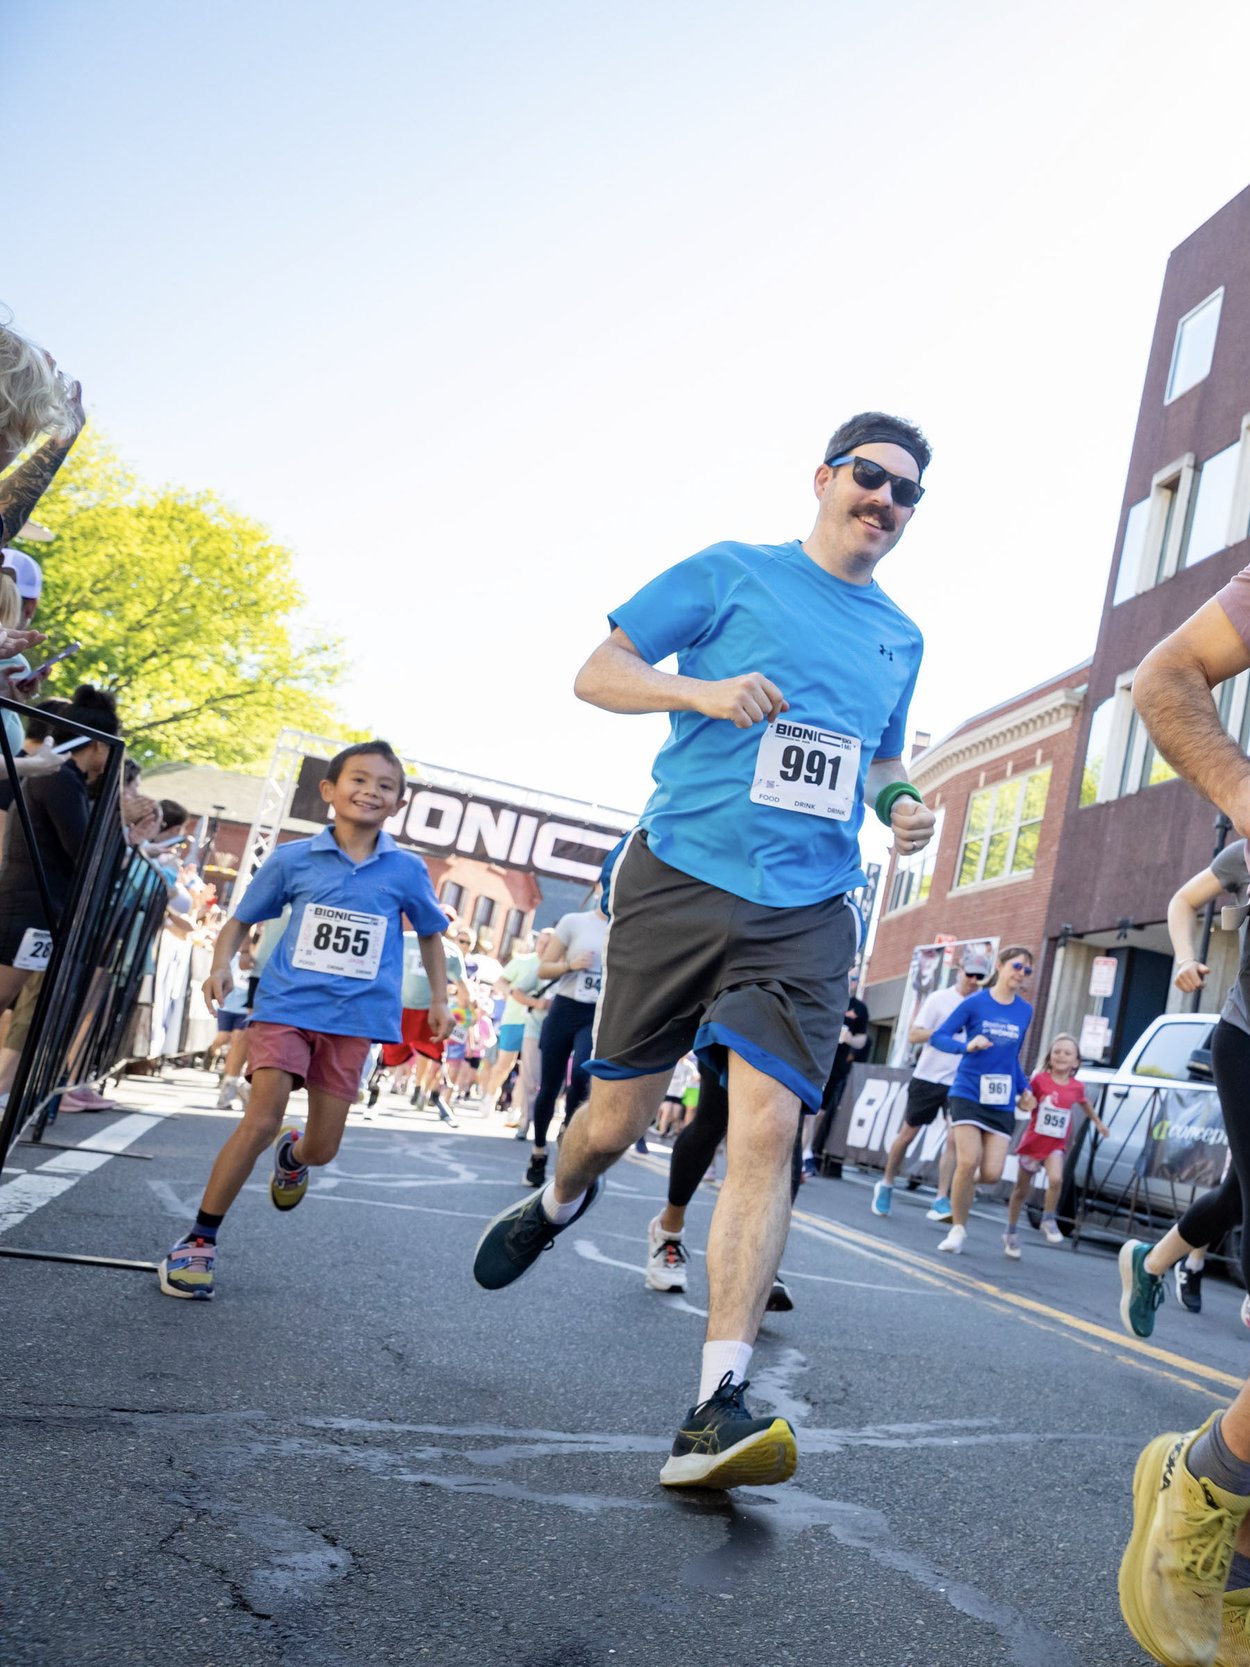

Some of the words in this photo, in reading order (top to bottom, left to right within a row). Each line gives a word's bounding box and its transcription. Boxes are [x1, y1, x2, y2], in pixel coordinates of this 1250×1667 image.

[775, 723, 842, 748] BIONIC
[779, 745, 842, 791] 991
[758, 793, 780, 803] FOOD
[794, 800, 816, 810] DRINK
[827, 807, 846, 816] DRINK
[328, 787, 625, 882] ONIC
[314, 907, 372, 925] BIONIC
[313, 923, 370, 957] 855
[988, 1082, 1008, 1094] 961
